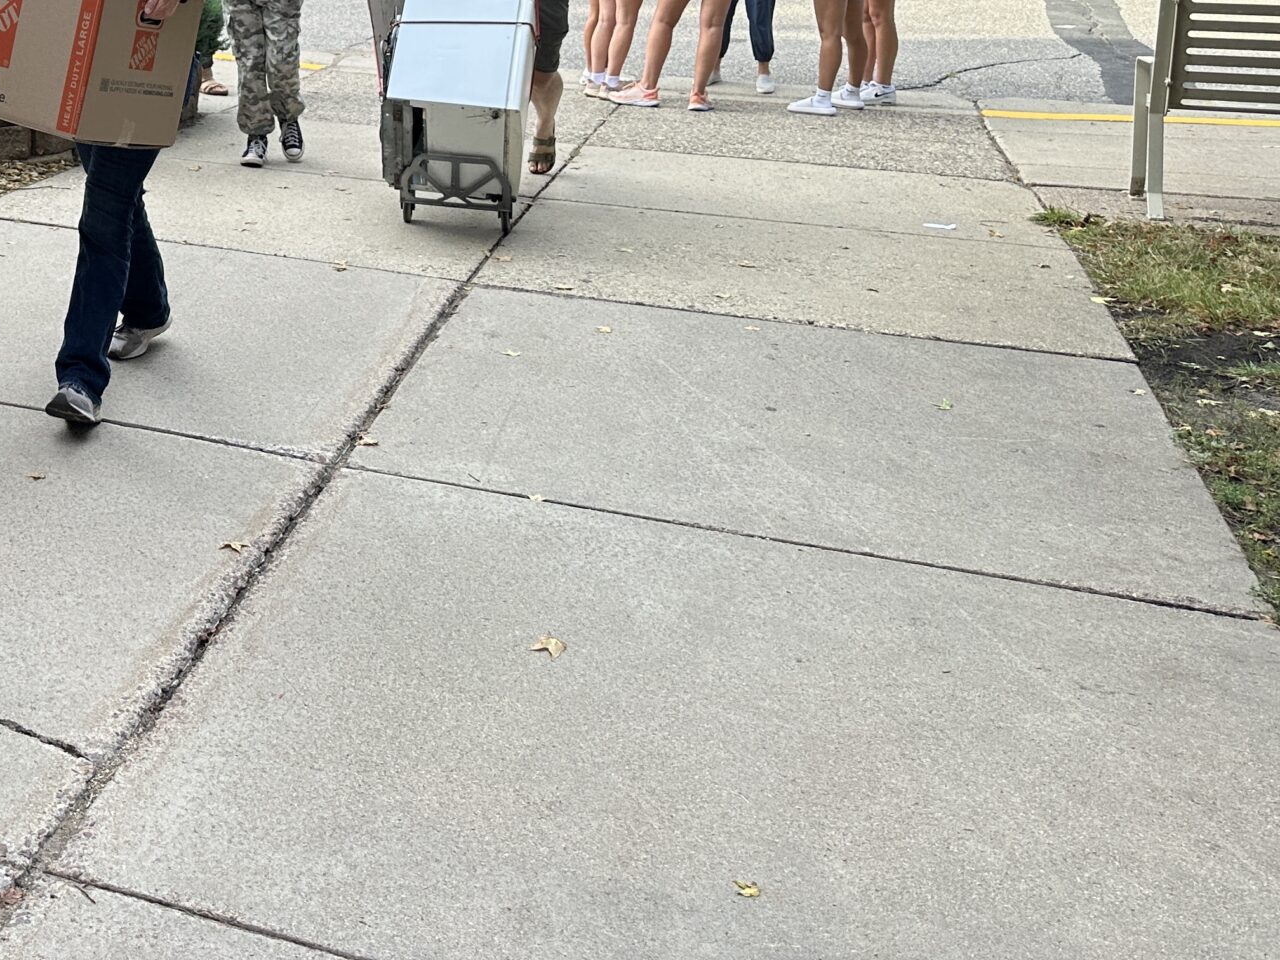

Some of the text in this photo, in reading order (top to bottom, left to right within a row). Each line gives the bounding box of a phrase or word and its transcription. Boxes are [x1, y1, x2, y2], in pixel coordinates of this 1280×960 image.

[62, 91, 74, 127] HEAVY
[70, 61, 81, 88] DUTY
[76, 11, 92, 55] LARGE
